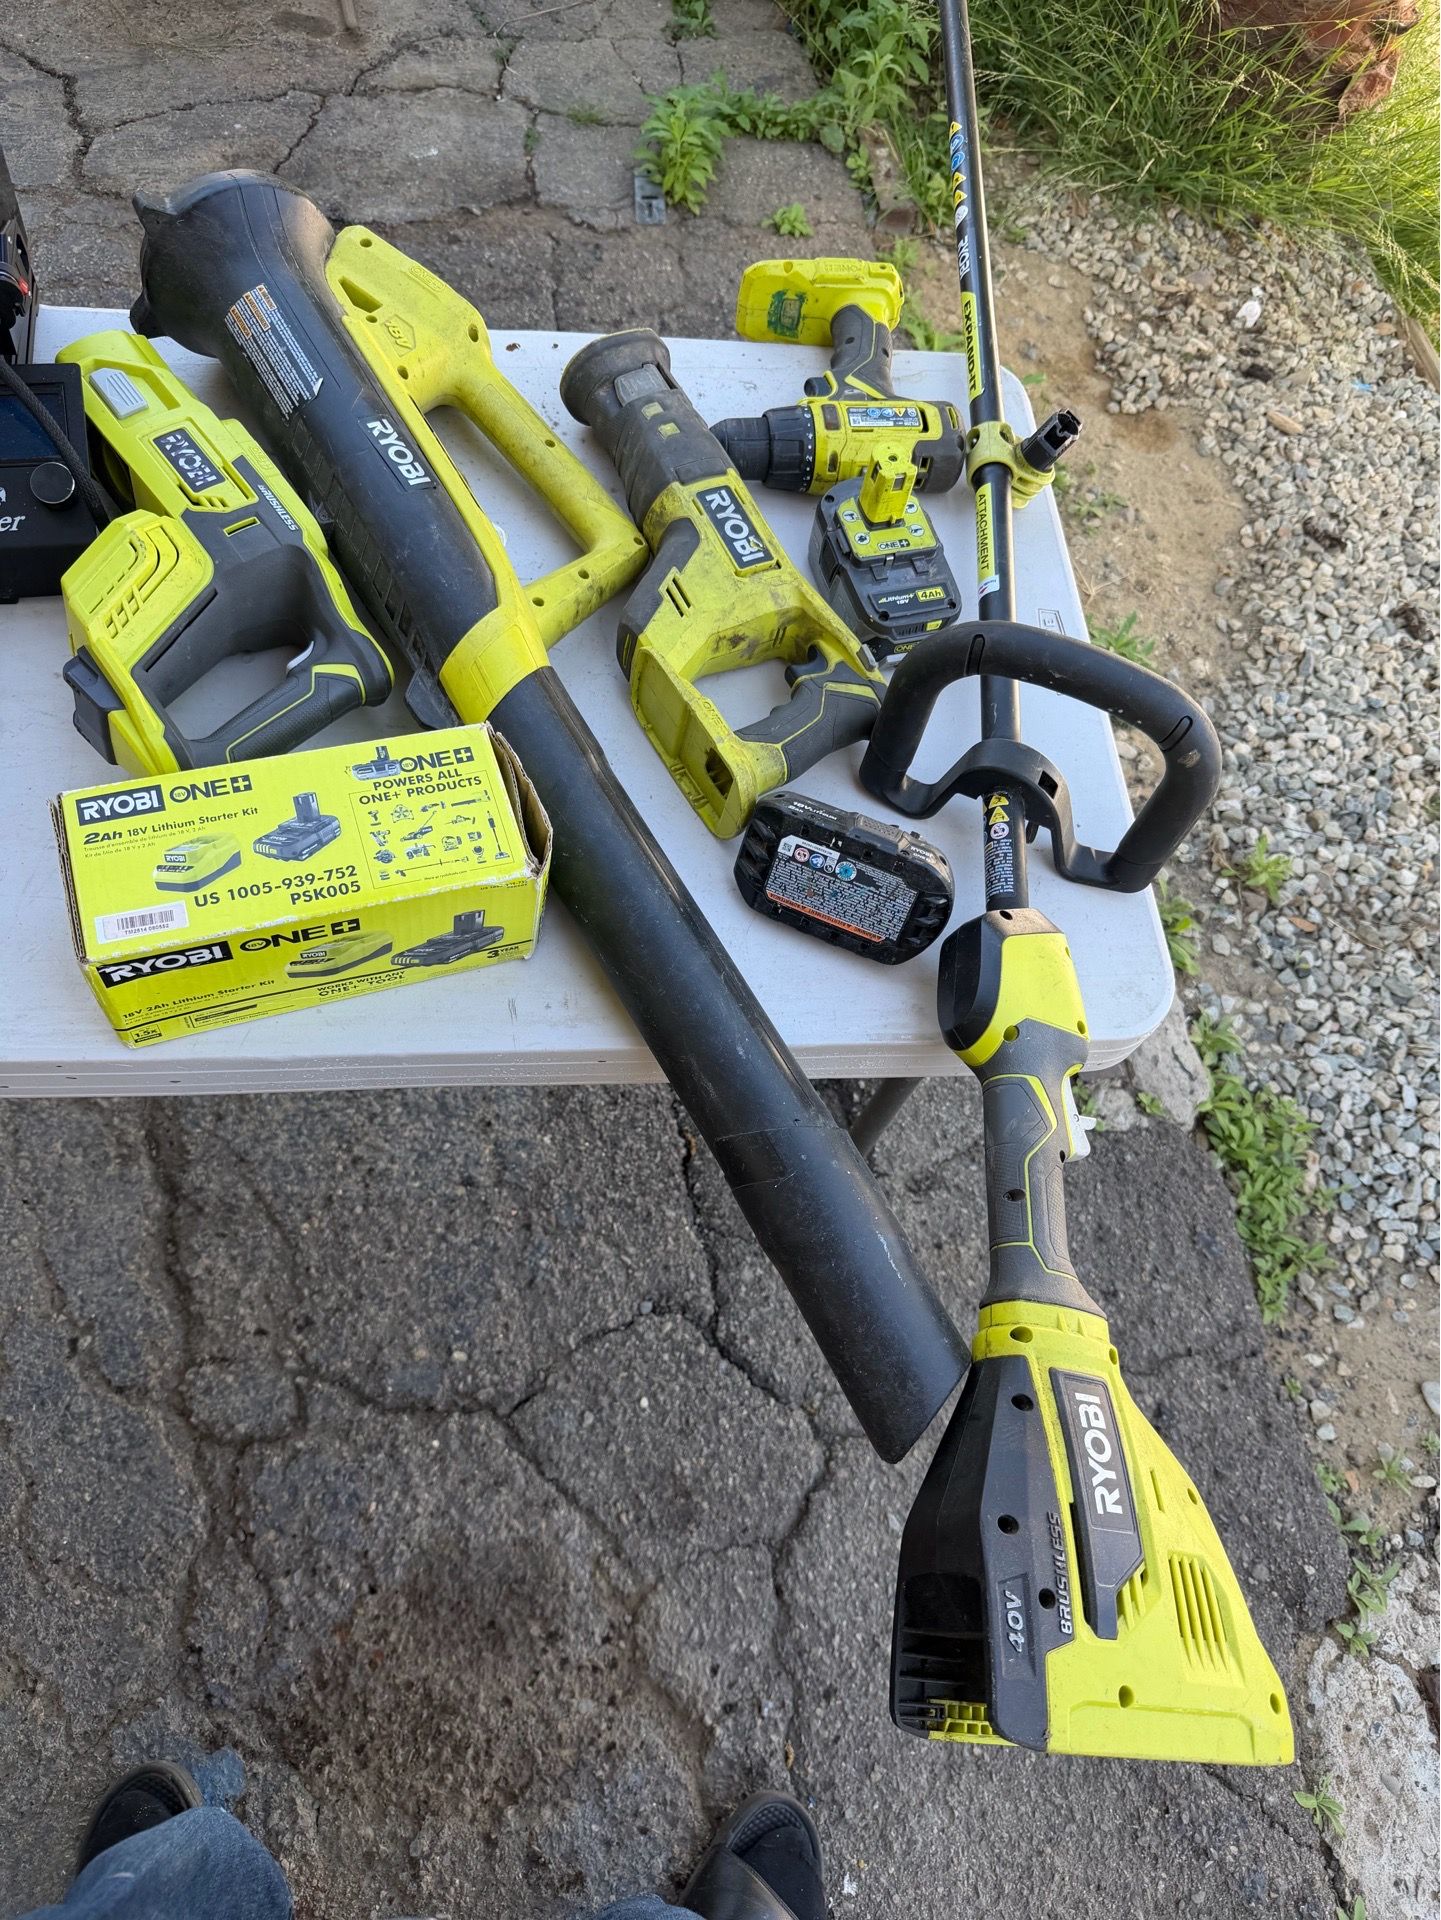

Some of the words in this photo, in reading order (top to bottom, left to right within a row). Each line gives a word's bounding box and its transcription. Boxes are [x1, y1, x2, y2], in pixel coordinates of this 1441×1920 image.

[160, 434, 217, 486] RYOBI
[366, 418, 432, 486] RYOBI
[257, 484, 299, 531] BRUSHLESS
[705, 489, 765, 563] RYOBI
[978, 493, 990, 570] ATTACHMENT
[879, 538, 911, 550] ONE+
[920, 588, 942, 599] 4Ah
[400, 746, 475, 773] ONE+
[169, 774, 253, 804] ONE+
[359, 790, 401, 805] ONE+
[406, 776, 482, 797] PRODUCTS
[373, 773, 433, 791] POWERS
[437, 768, 463, 781] ALL
[80, 789, 162, 821] RYOBI
[83, 831, 123, 845] 2Ah
[127, 826, 148, 838] 18V
[151, 818, 196, 833] Lithium
[198, 811, 239, 825] Starter
[241, 807, 258, 817] Kit
[166, 854, 186, 862] RYOBI
[194, 891, 221, 908] US
[227, 864, 358, 902] 1005-939-752
[290, 880, 361, 906] PSK005
[239, 918, 361, 952] ONE+
[247, 940, 266, 950] 18V
[101, 945, 227, 983] RYOBI
[302, 951, 326, 959] RYOBI
[486, 949, 500, 959] 3
[316, 980, 354, 992] WORKS
[356, 975, 382, 984] WITH
[384, 970, 406, 979] ANY
[318, 984, 360, 997] ONE+
[367, 974, 406, 986] TOOL
[122, 1008, 143, 1019] 18V
[146, 1001, 170, 1013] 2Ah
[172, 991, 215, 1006] Lithium
[217, 982, 256, 996] Starter
[259, 978, 276, 986] Kit
[1074, 1391, 1123, 1516] RYOBI
[1046, 1510, 1073, 1636] BRUSHLESS
[1003, 1590, 1023, 1653] 40V
